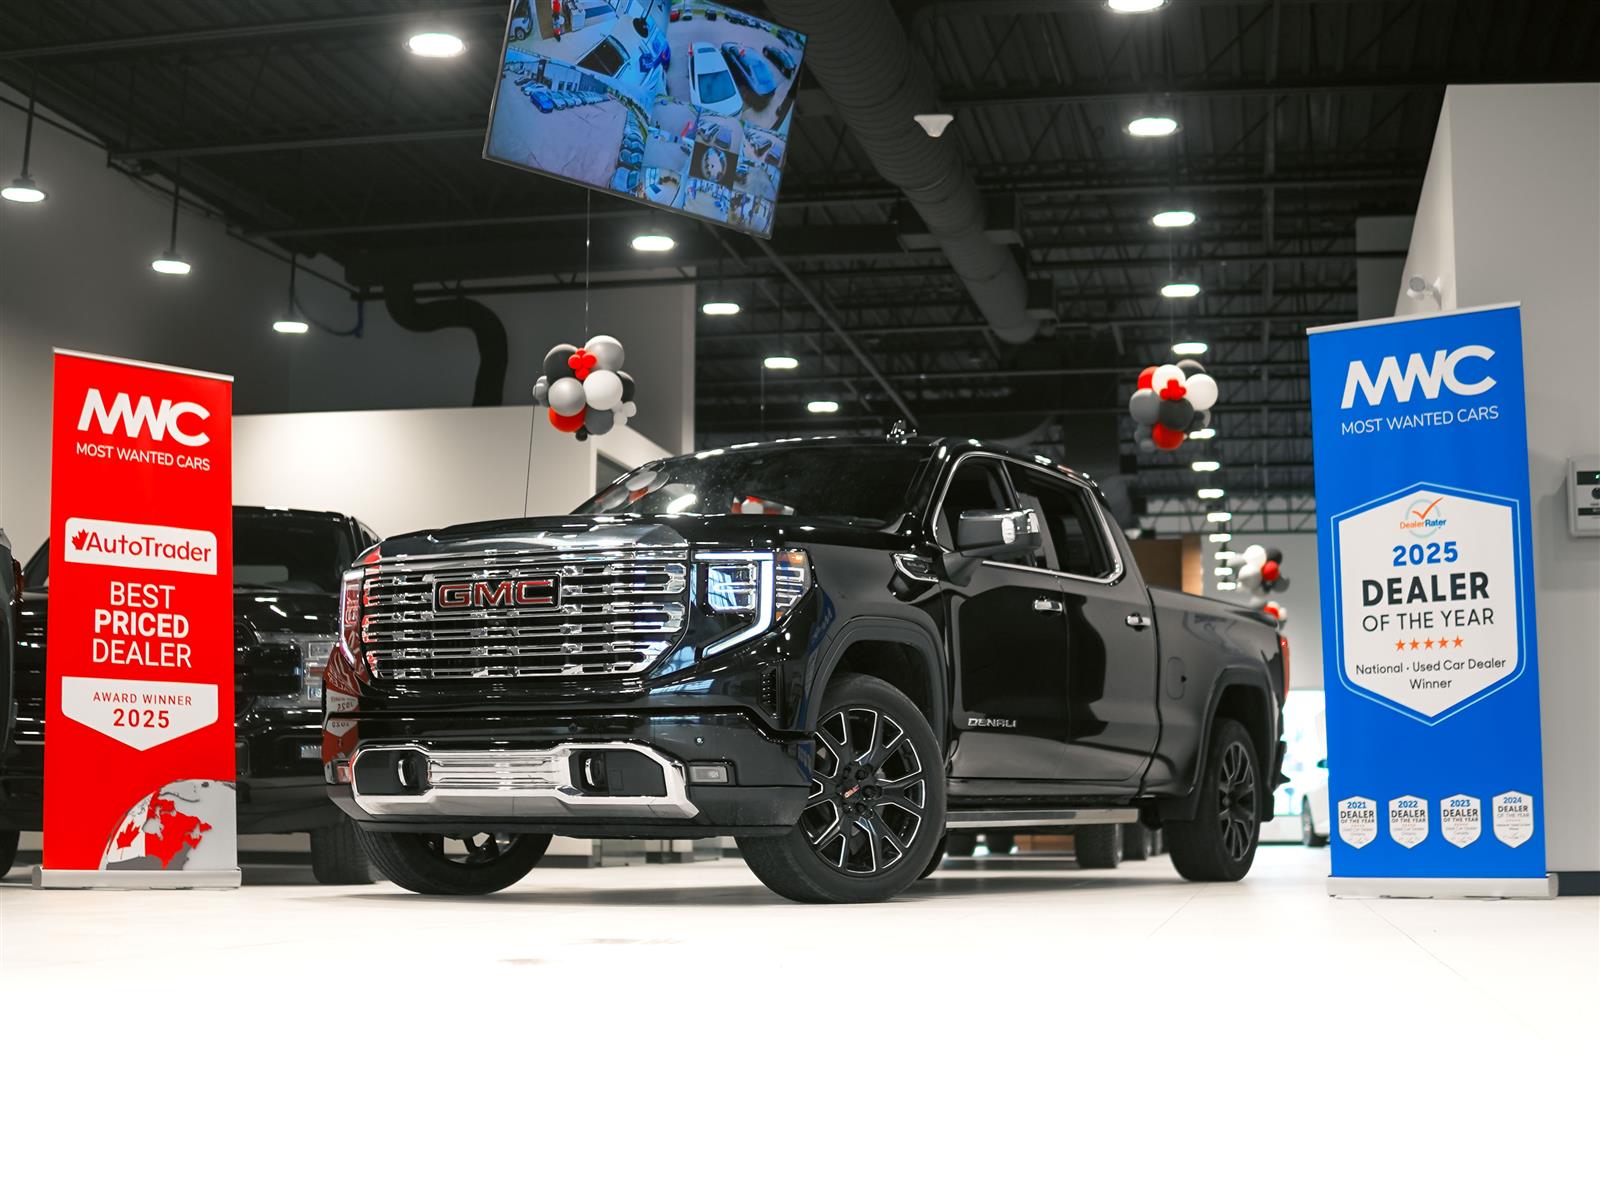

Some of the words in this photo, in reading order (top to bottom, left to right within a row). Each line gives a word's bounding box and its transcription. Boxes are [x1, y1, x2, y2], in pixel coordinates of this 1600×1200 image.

[1340, 345, 1497, 410] MWC
[77, 388, 211, 447] MWC
[1341, 418, 1384, 436] MOST
[1386, 410, 1454, 431] WANTED
[1457, 405, 1499, 422] CARS
[76, 442, 114, 459] MOST
[116, 447, 174, 467] WANTED
[176, 455, 211, 472] CARS
[86, 531, 212, 562] AutoTrader
[1392, 541, 1459, 567] 2025
[110, 581, 176, 609] BEST
[438, 580, 554, 609] GMC
[1361, 571, 1490, 607] DEALER
[94, 608, 190, 639] PRICED
[1362, 614, 1390, 632] OF
[1396, 611, 1434, 630] THE
[1440, 608, 1495, 627] YEAR
[92, 638, 192, 668] DEALER
[1355, 662, 1404, 675] National
[1413, 660, 1441, 672] Used
[1443, 660, 1465, 671] Car
[1467, 657, 1507, 670] Dealer
[1409, 678, 1452, 690] Winner
[92, 691, 138, 704] AWARD
[142, 693, 192, 706] WINNER
[113, 708, 170, 729] 2025
[1347, 801, 1367, 809] 2021
[1398, 800, 1418, 808] 2022
[1450, 799, 1471, 807] 2023
[1497, 805, 1529, 813] DEALER
[1503, 796, 1522, 804] 2024
[1340, 810, 1375, 819] DEALER
[1391, 809, 1426, 818] DEALER
[1443, 808, 1478, 817] DEALER
